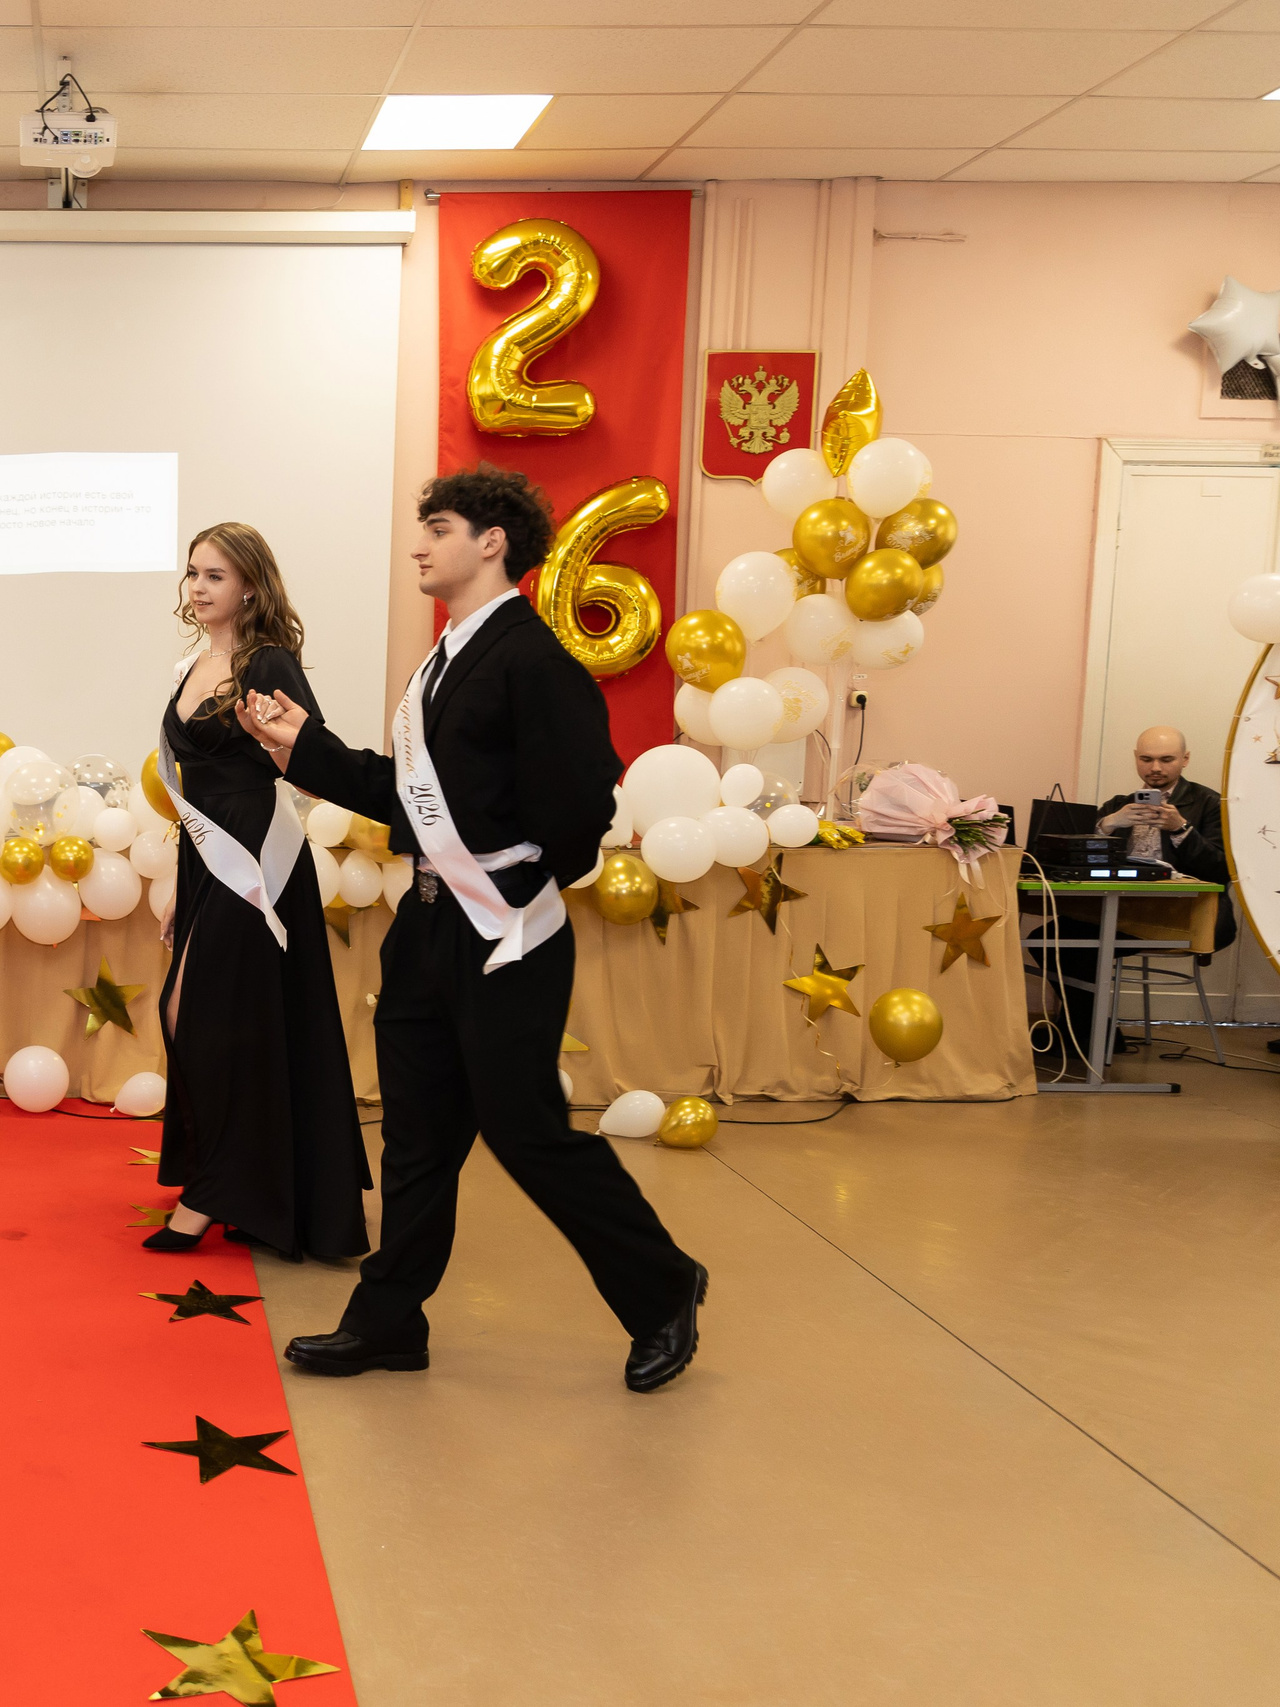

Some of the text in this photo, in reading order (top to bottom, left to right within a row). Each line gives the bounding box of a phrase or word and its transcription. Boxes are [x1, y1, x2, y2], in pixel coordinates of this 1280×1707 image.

[465, 218, 601, 437] 2
[39, 490, 82, 501] истории
[84, 491, 107, 500] есть
[109, 490, 134, 500] свой
[26, 518, 57, 528] новое
[59, 517, 95, 527] начало
[39, 505, 70, 514] конец
[81, 505, 123, 514] истории
[134, 506, 152, 514] это
[532, 475, 670, 683] 6
[407, 783, 445, 826] 2026
